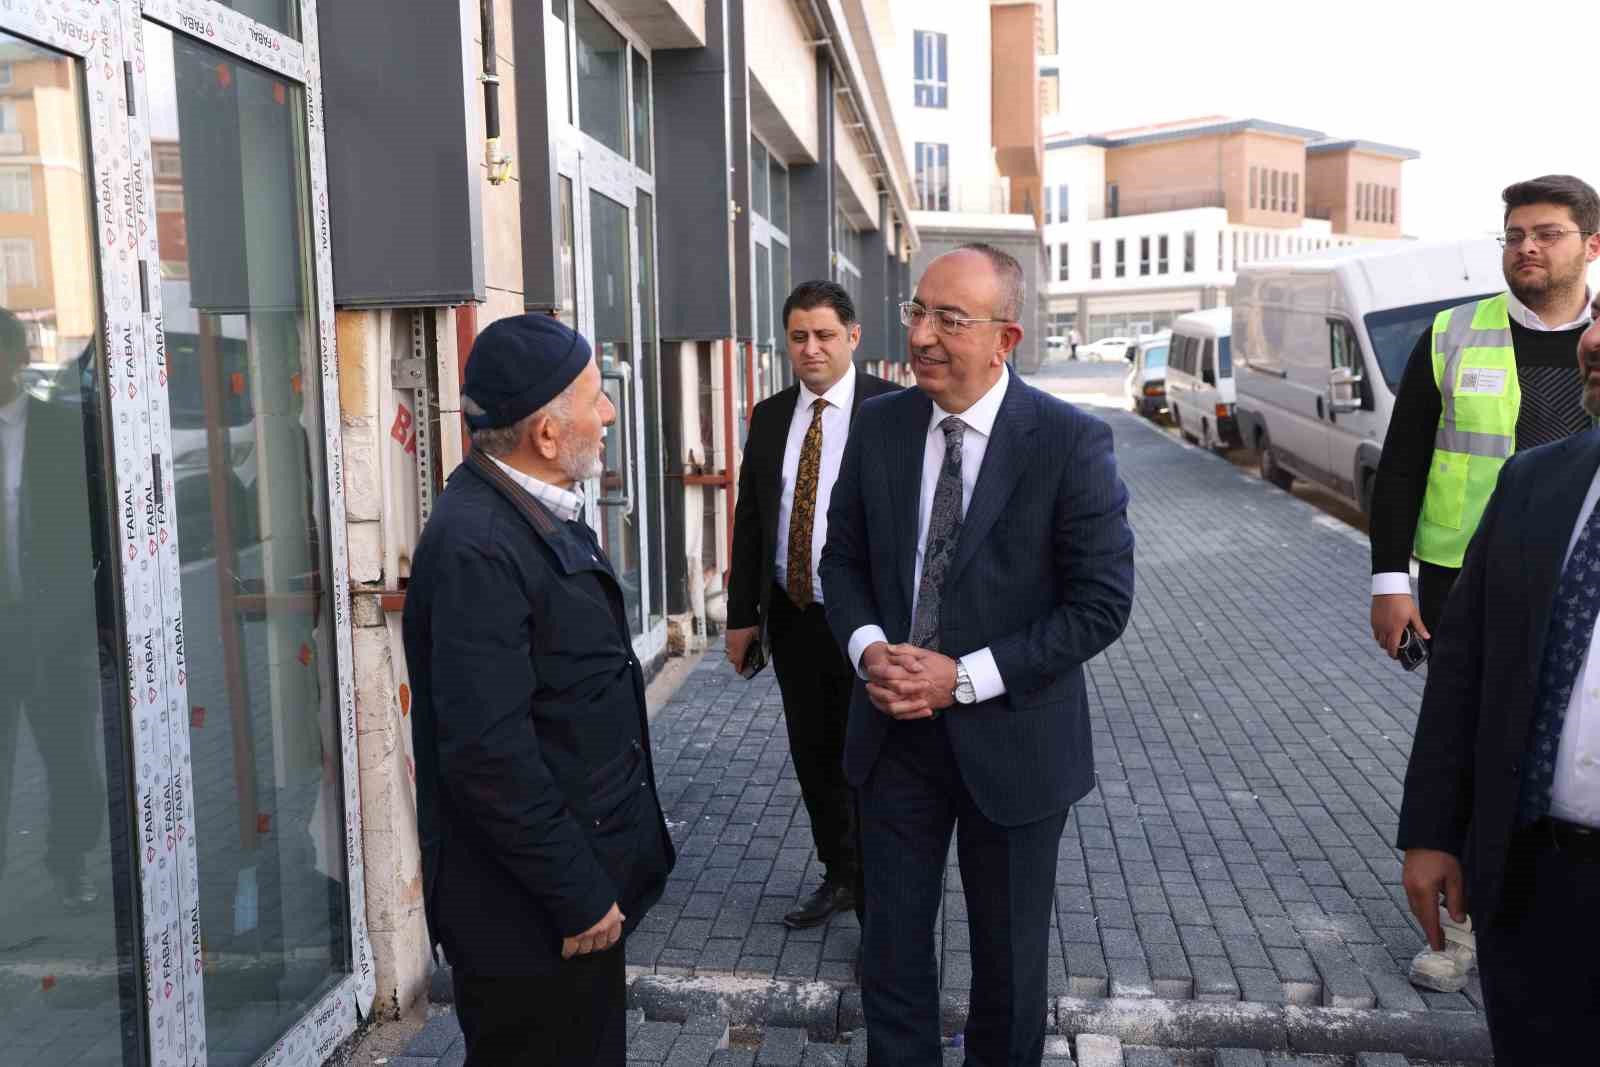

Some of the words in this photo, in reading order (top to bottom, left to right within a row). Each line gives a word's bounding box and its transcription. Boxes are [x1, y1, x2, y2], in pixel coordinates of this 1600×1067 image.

[176, 11, 204, 34] FABAL
[249, 26, 272, 49] FABAL
[101, 168, 113, 225] FABAL
[123, 173, 134, 228] FABAL
[133, 160, 144, 216] FABAL
[123, 320, 135, 378] FABAL
[155, 313, 165, 366] FABAL
[124, 482, 135, 540] FABAL
[145, 481, 155, 536] FABAL
[144, 629, 154, 684] FABAL
[174, 611, 184, 666] FABAL
[144, 786, 153, 843] FABAL
[163, 777, 173, 833] FABAL
[174, 768, 183, 821] FABAL
[162, 924, 170, 979] FABAL
[192, 901, 200, 956] FABAL
